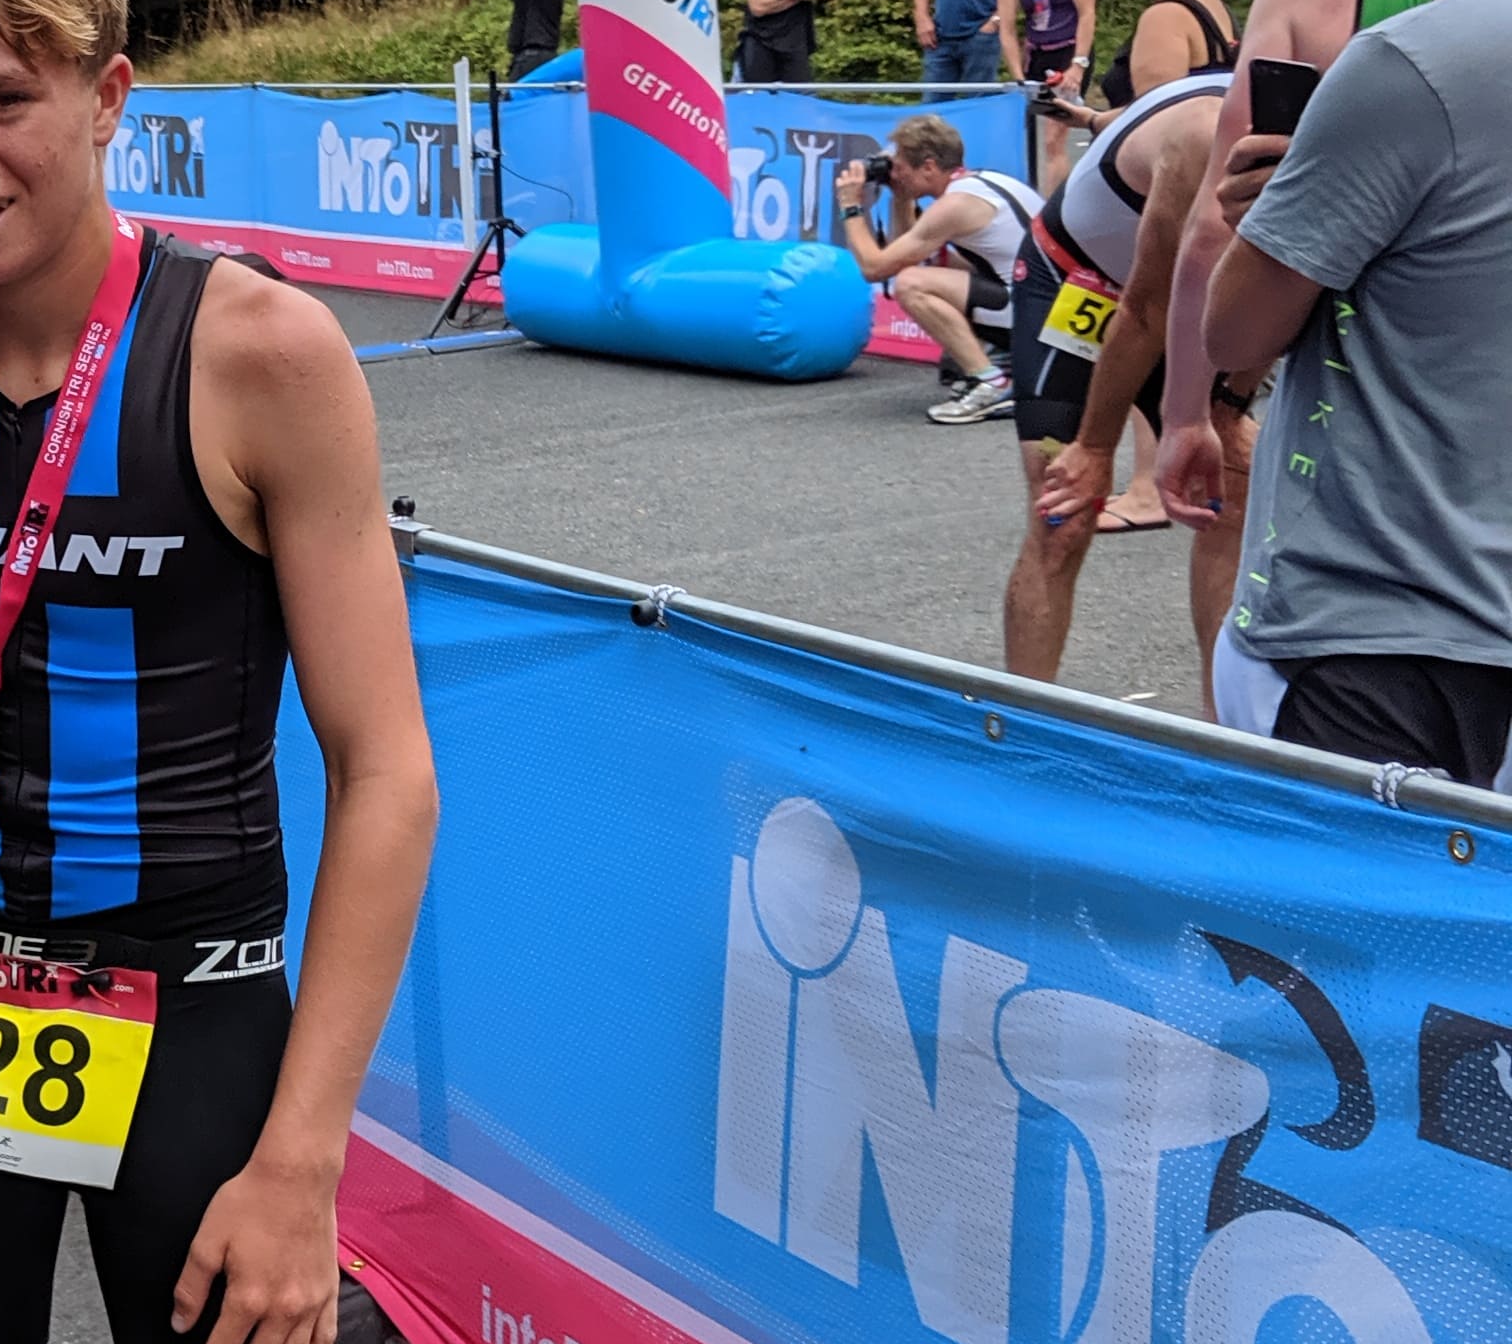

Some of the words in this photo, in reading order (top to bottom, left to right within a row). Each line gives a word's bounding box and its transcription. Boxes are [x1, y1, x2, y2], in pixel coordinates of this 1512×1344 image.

[623, 63, 672, 102] GET
[44, 400, 75, 464] CORNISH
[66, 373, 84, 398] TRI
[75, 322, 104, 373] SERIES
